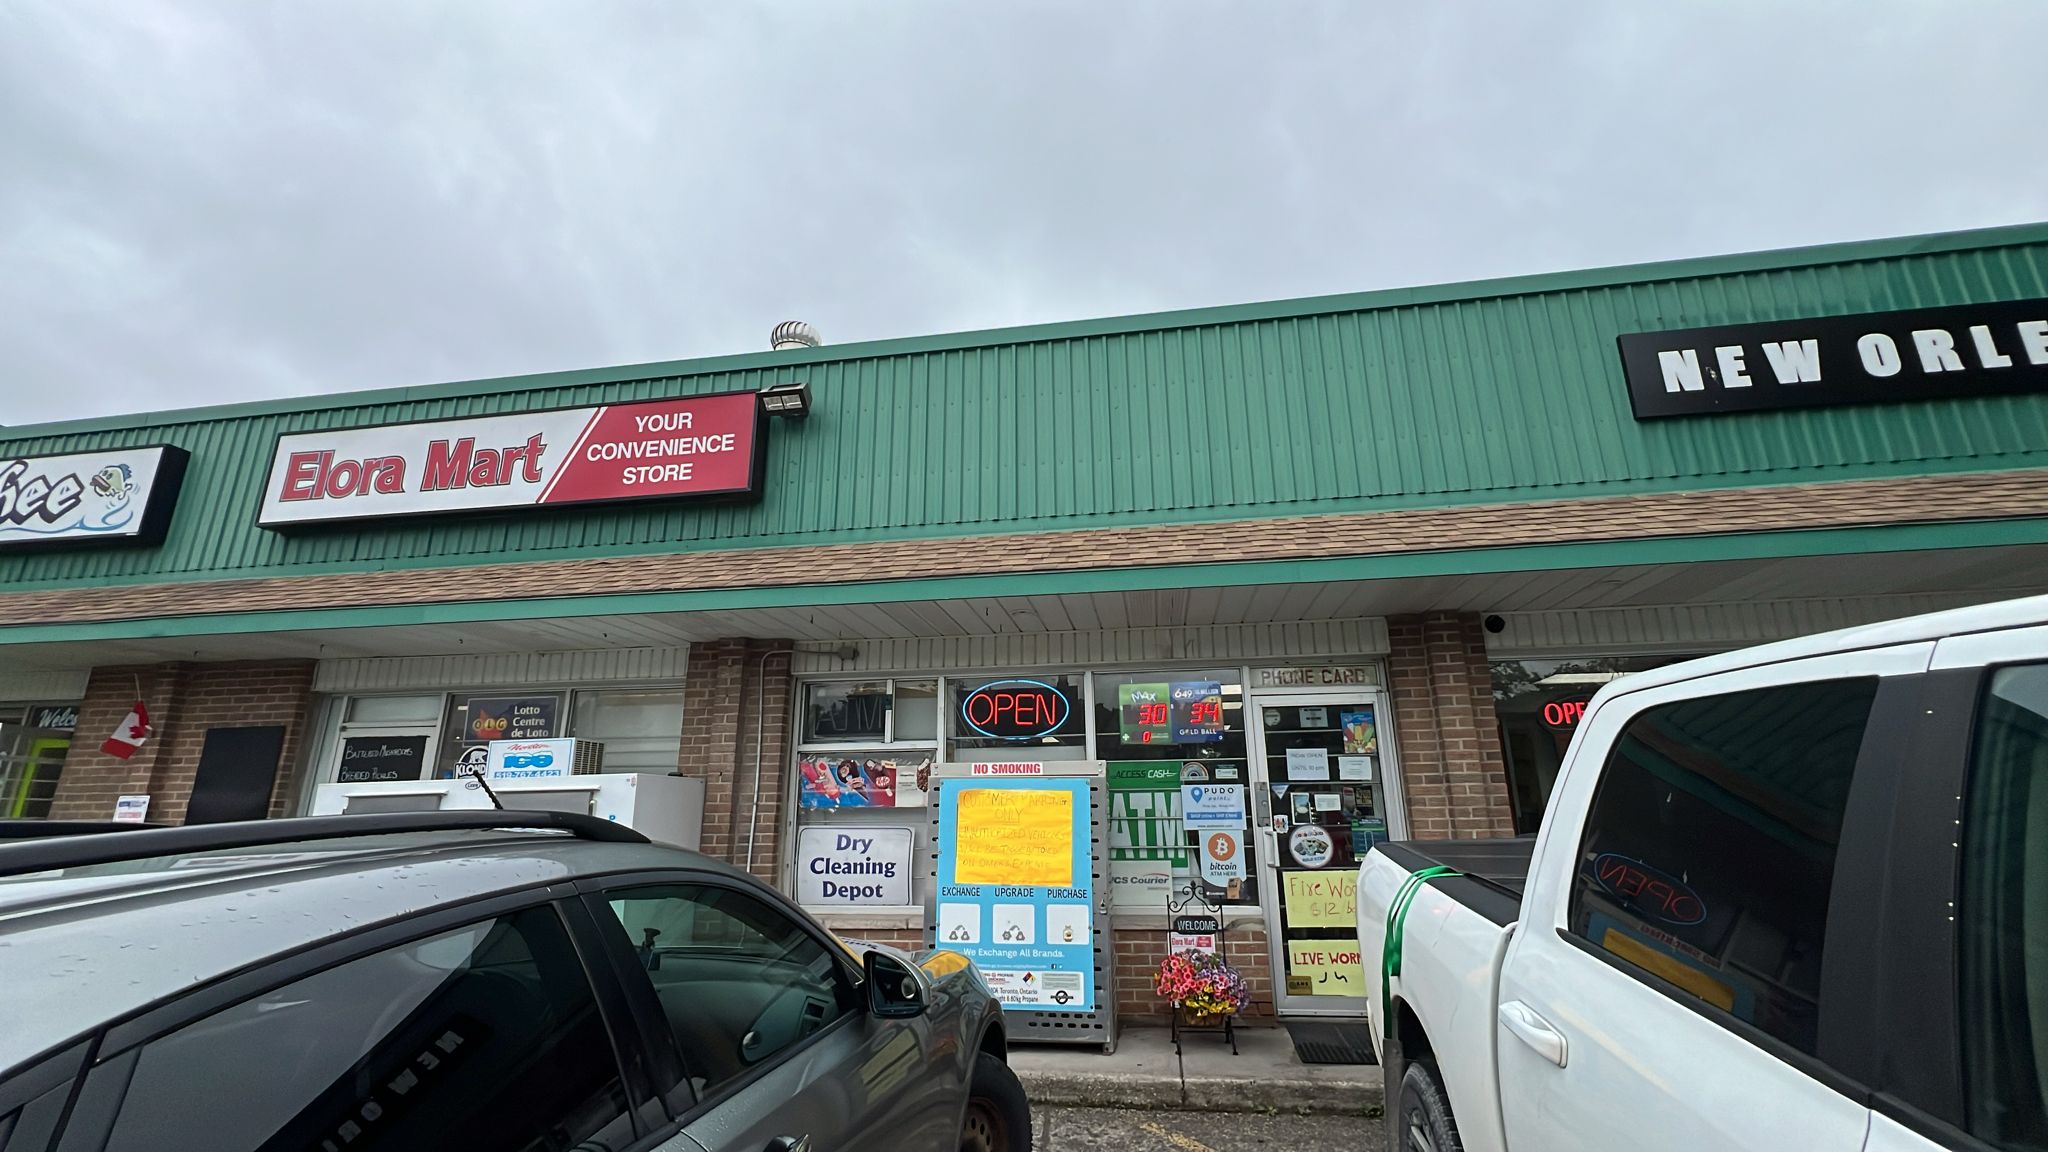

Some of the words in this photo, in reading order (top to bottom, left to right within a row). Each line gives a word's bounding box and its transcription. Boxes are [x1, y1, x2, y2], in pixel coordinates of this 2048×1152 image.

[1657, 338, 1823, 393] NEW
[1856, 319, 2048, 378] ORLE
[635, 411, 693, 434] YOUR
[585, 433, 736, 462] CONVENIENCE
[278, 449, 407, 503] Elora
[420, 431, 548, 492] Mart
[621, 462, 693, 486] STORE
[1261, 670, 1313, 686] PHONE
[1321, 668, 1366, 684] CARD
[1174, 688, 1193, 698] 649
[514, 705, 541, 715] Lotto
[968, 693, 1057, 726] OPEN
[1139, 703, 1168, 725] 30
[1190, 703, 1219, 724] 34
[1543, 701, 1591, 726] OPE
[512, 717, 545, 727] Centre
[511, 729, 524, 738] de
[526, 728, 549, 738] Loto
[1142, 730, 1152, 743] 0
[973, 763, 988, 774] NO
[991, 763, 1041, 774] SMOKING
[1147, 769, 1173, 778] CASH
[1110, 791, 1186, 859] ATM
[835, 834, 873, 855] Dry
[809, 857, 897, 878] Cleaning
[1209, 862, 1237, 871] bitcoin
[1130, 876, 1169, 884] Courier
[1290, 877, 1323, 896] Fire
[822, 880, 884, 902] Depot
[942, 887, 981, 897] EXCHANGE
[994, 887, 1034, 897] UPGRADE
[1047, 888, 1088, 898] PURCHASE
[1177, 920, 1217, 931] WELCOME
[963, 948, 976, 956] We
[978, 948, 1018, 959] Exchange
[1019, 949, 1031, 957] All
[1032, 949, 1065, 958] Brands.
[1293, 952, 1325, 966] LIVE
[1328, 952, 1361, 965] WOR
